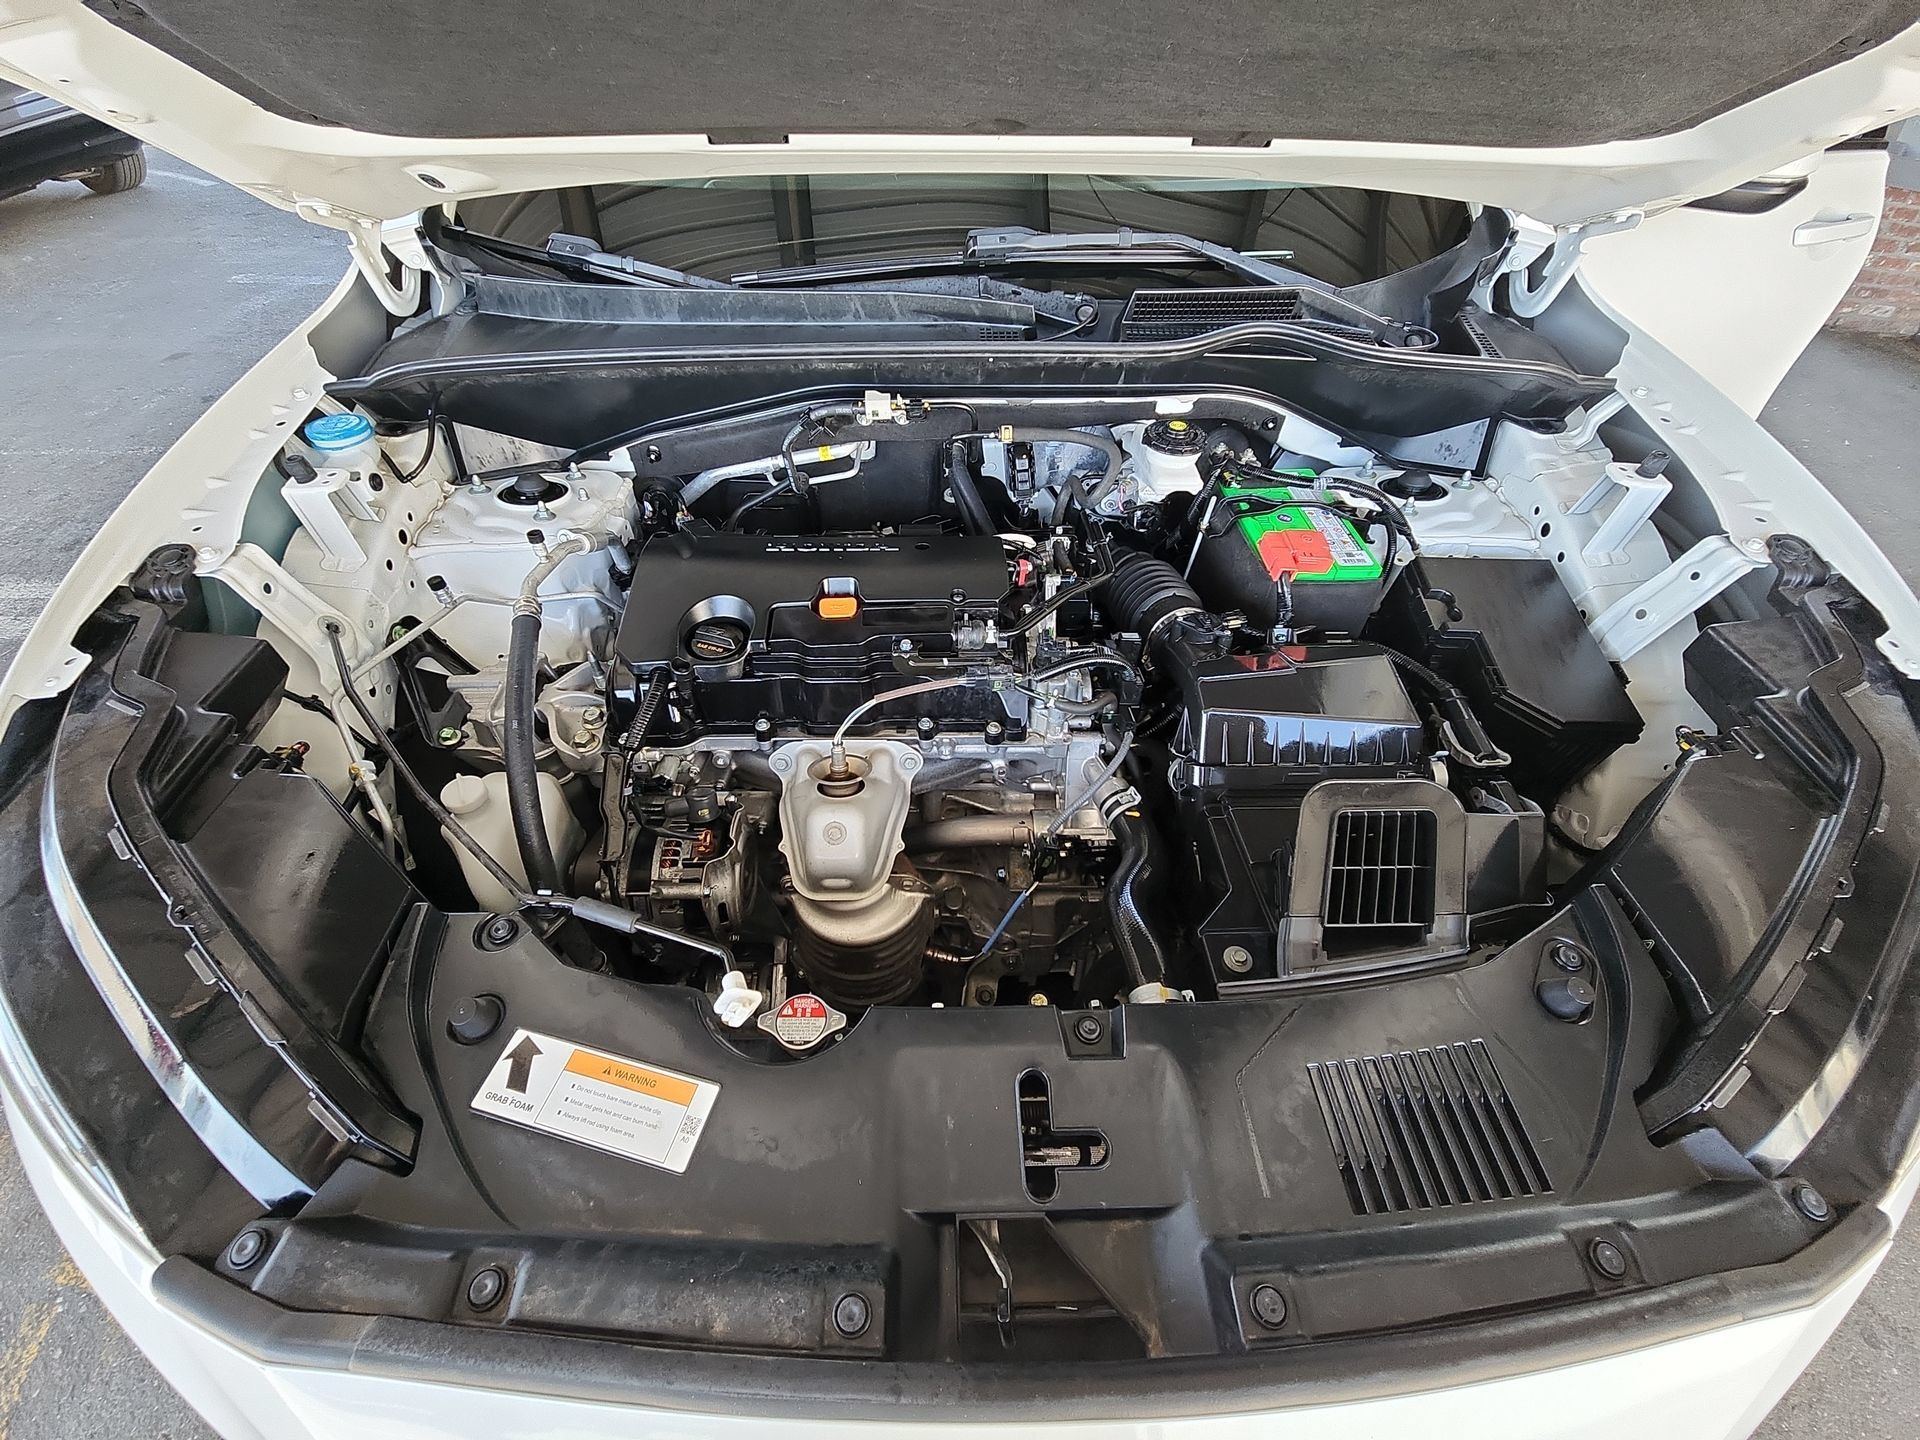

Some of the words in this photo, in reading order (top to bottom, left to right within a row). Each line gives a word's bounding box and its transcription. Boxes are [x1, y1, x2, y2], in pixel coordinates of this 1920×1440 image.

[613, 1069, 657, 1088] WARNING
[485, 1092, 509, 1104] GRAB
[509, 1098, 534, 1112] FOAM
[569, 1098, 583, 1106] Metal
[591, 1105, 603, 1113] gets
[592, 1090, 607, 1098] touch
[606, 1094, 619, 1102] bare
[618, 1097, 633, 1106] metal
[638, 1103, 652, 1112] white
[561, 1112, 580, 1122] Always
[595, 1122, 610, 1131] using
[609, 1126, 623, 1134] foam
